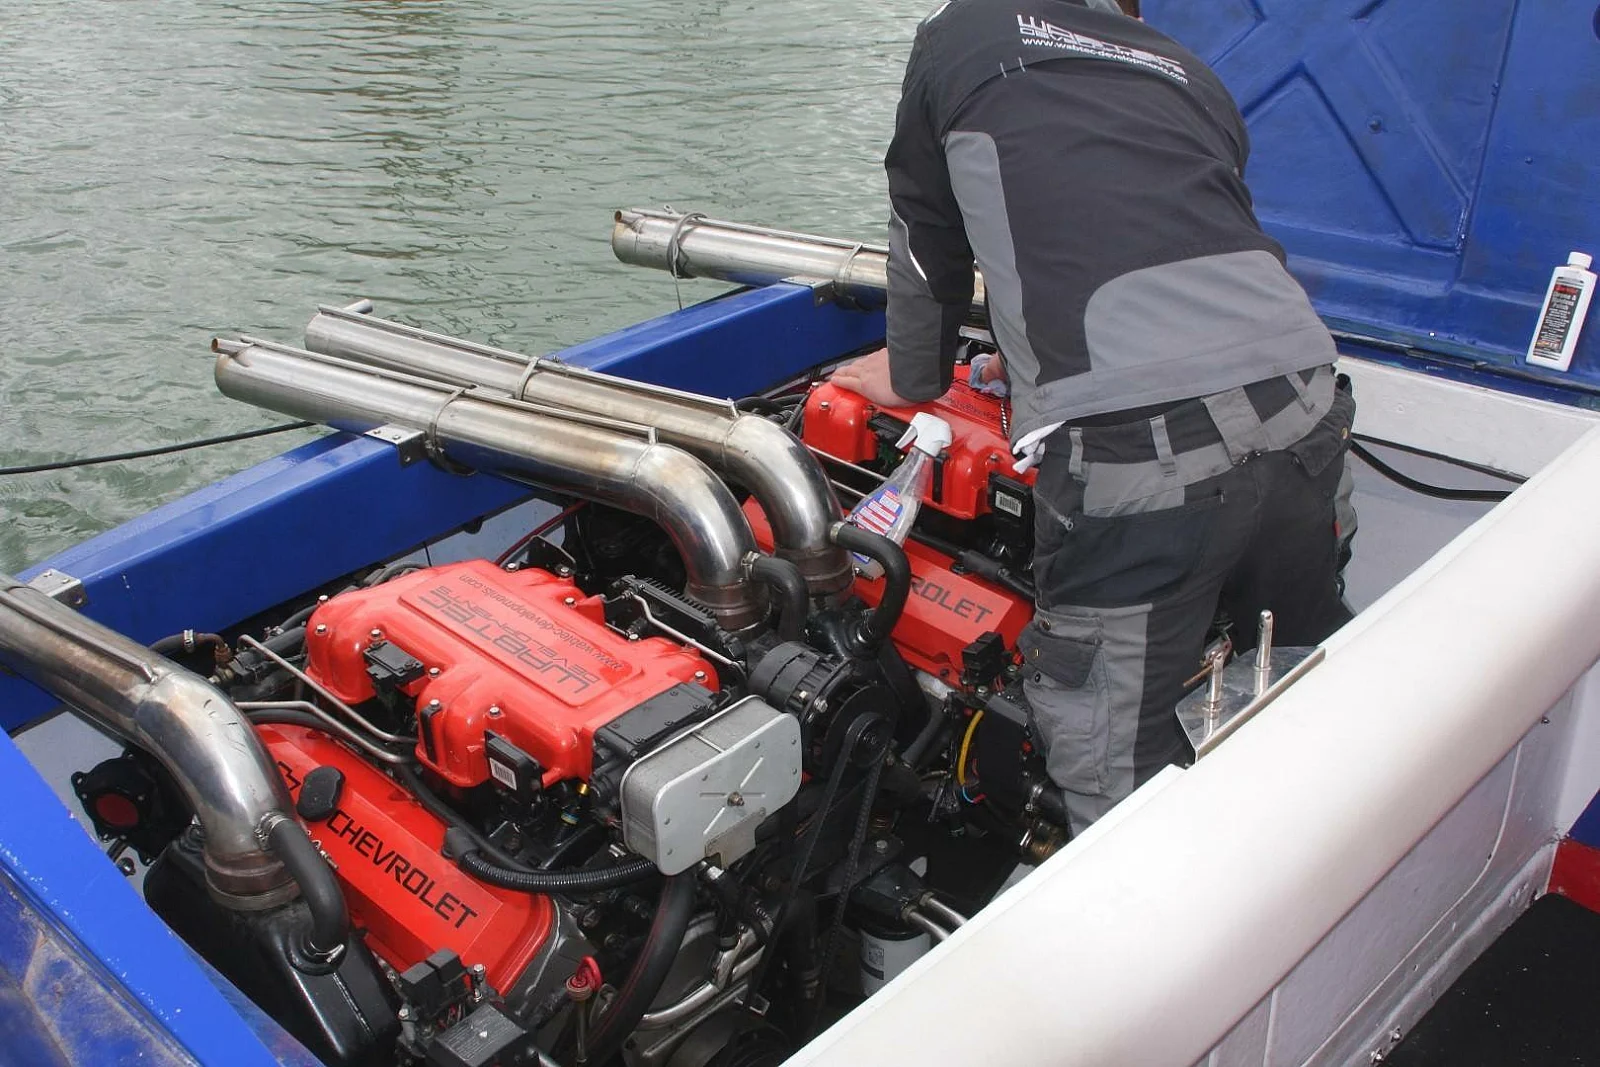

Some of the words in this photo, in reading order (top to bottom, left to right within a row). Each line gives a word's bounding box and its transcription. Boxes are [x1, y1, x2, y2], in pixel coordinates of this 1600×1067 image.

[419, 595, 591, 694] WABTEC
[430, 585, 601, 684] DEVELOPMENTS
[911, 575, 993, 624] ROLET
[326, 810, 478, 929] CHEVROLET
